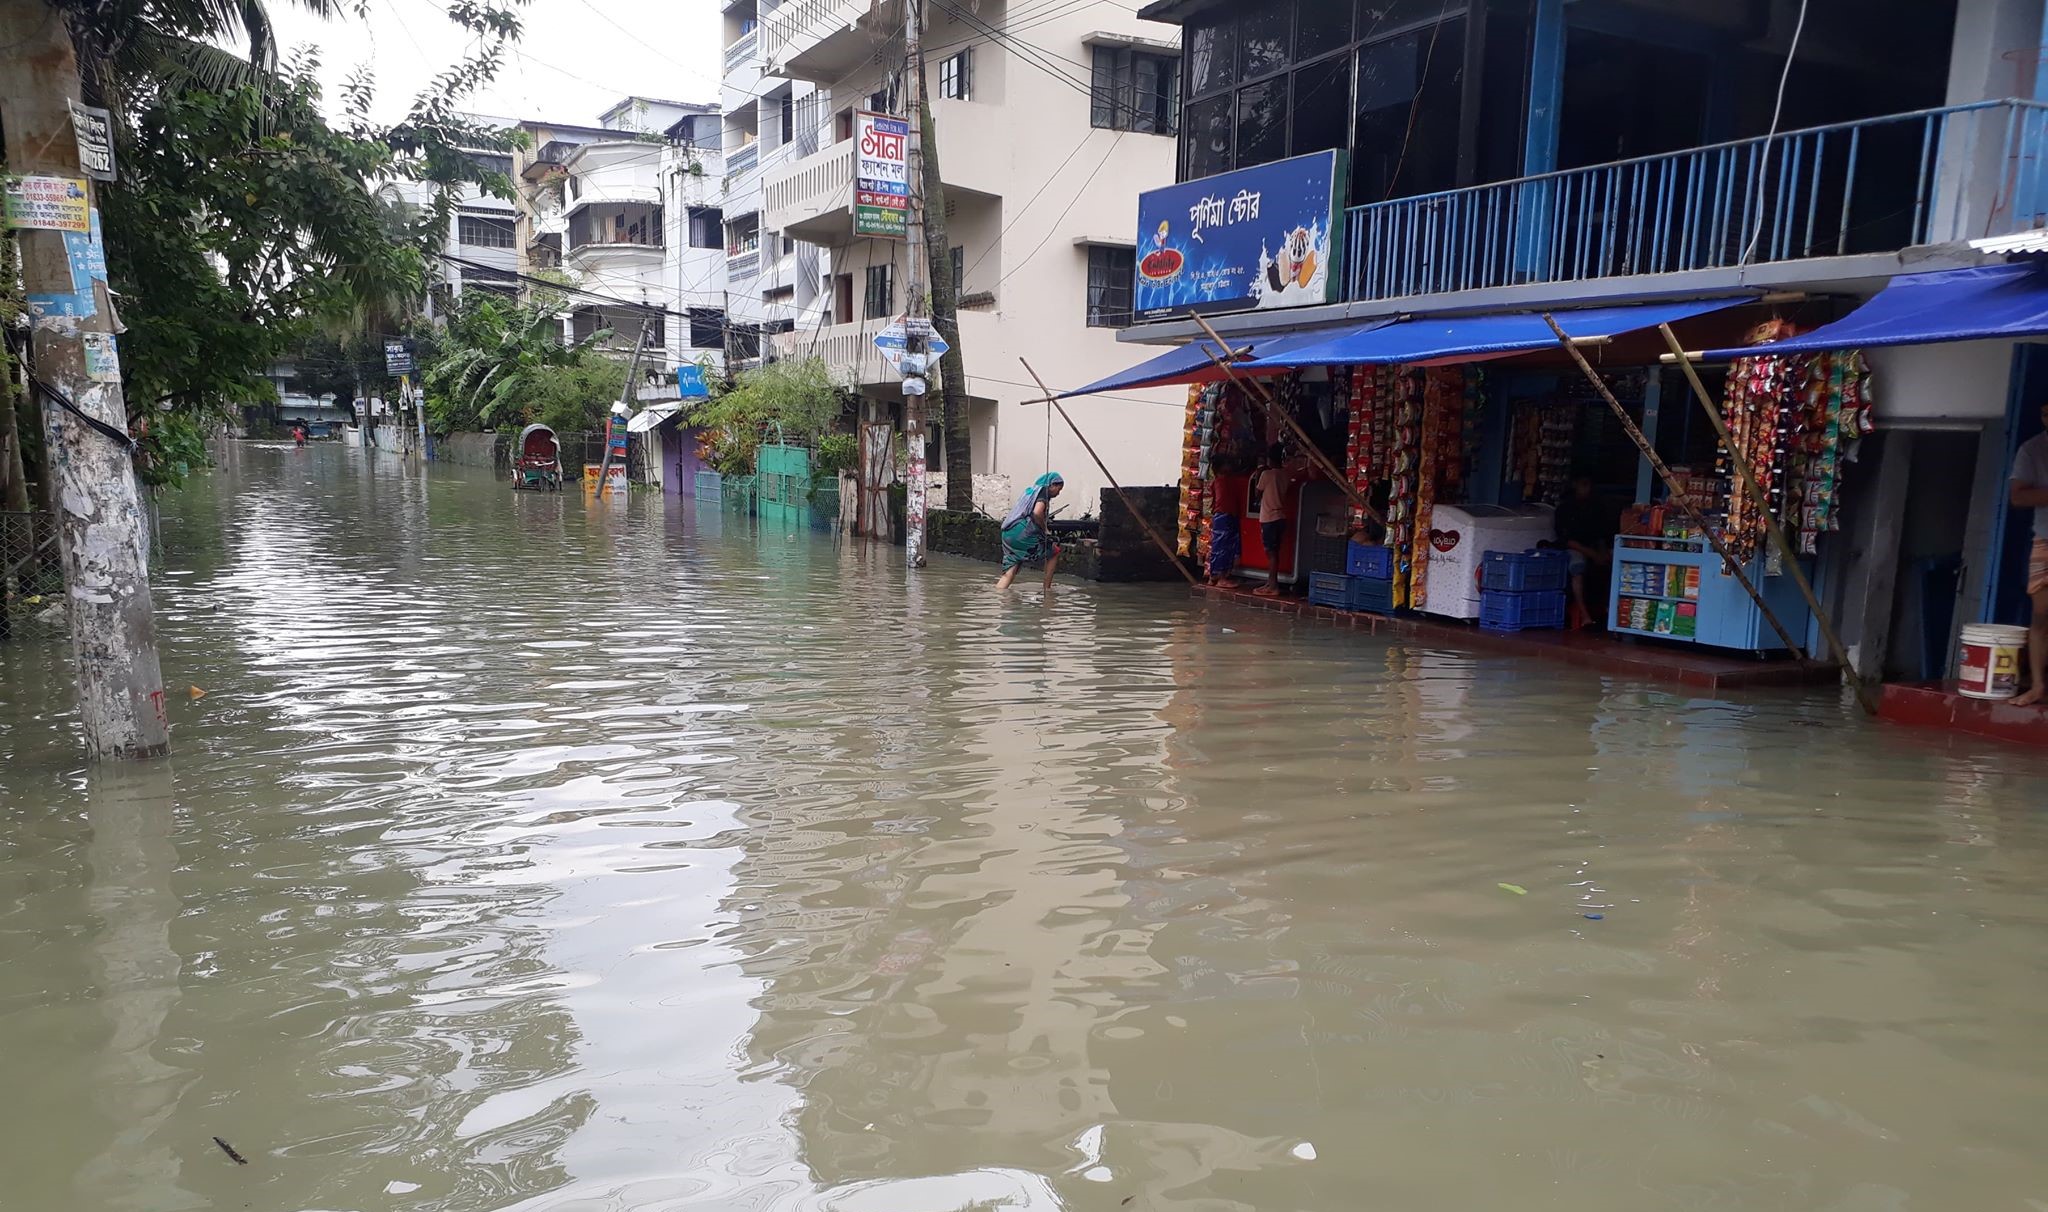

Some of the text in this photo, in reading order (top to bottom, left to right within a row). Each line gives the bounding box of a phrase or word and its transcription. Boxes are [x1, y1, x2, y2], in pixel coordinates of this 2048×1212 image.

[861, 124, 904, 161] সানা
[861, 160, 904, 180] ফ্যাশন মল
[1189, 189, 1261, 244] পূর্ণিমা ষ্টোর
